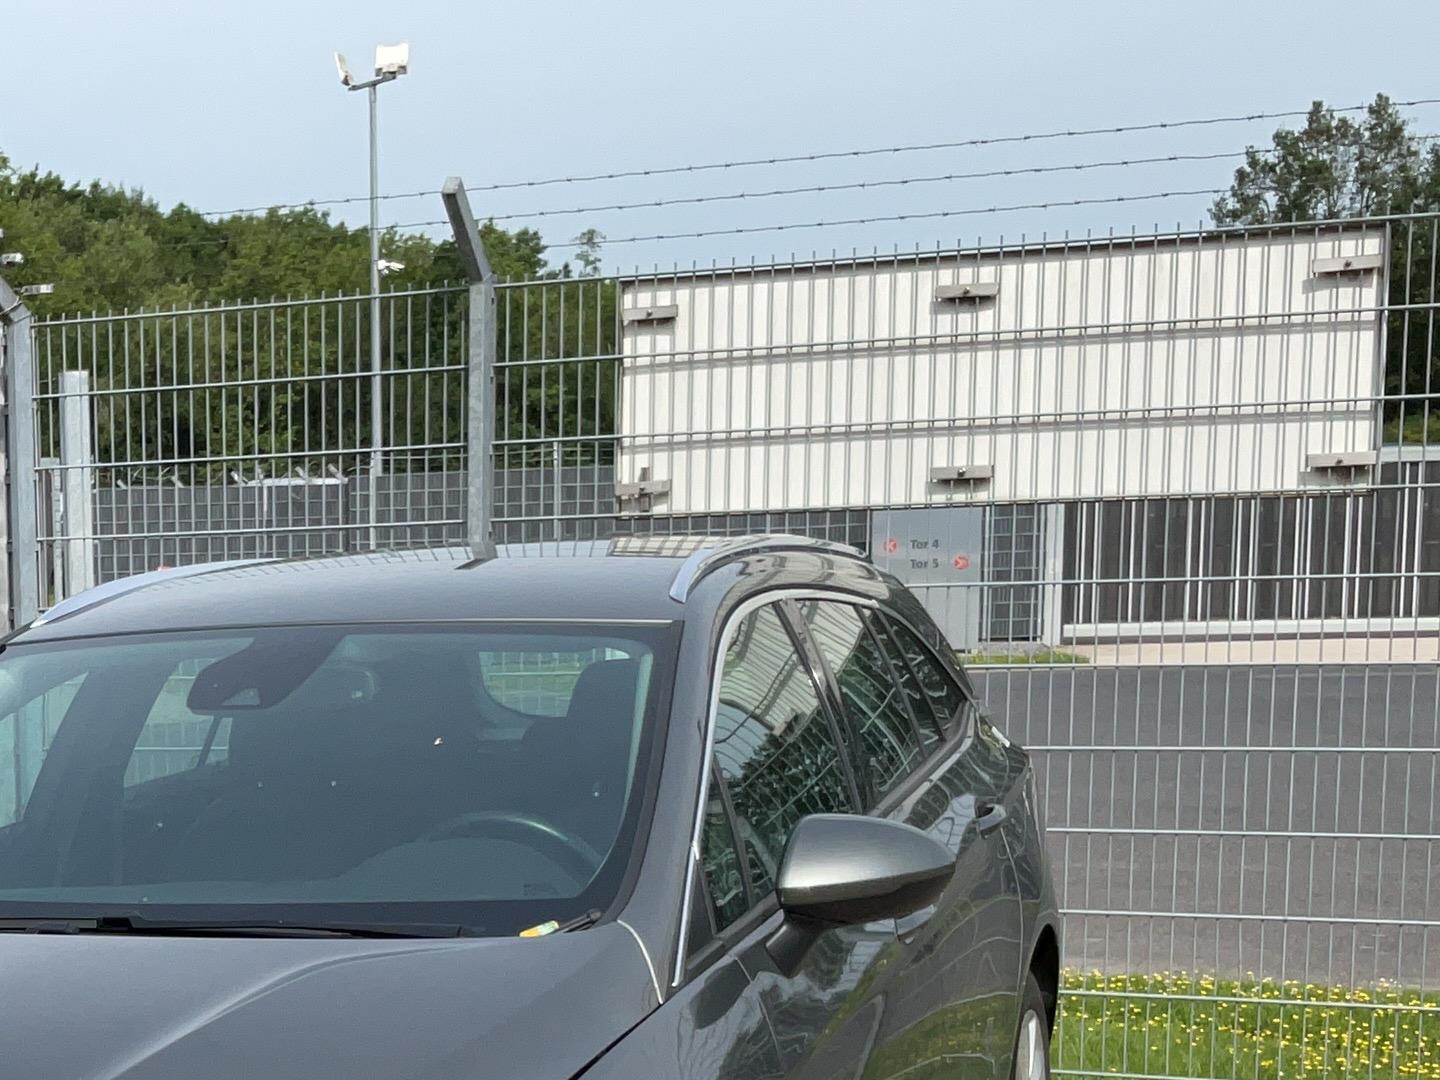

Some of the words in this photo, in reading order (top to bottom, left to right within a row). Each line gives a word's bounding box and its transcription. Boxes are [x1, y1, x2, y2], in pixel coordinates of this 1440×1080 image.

[910, 539, 928, 549] Tor
[931, 539, 939, 549] 4
[910, 559, 928, 569] Tor
[932, 558, 939, 568] 5
